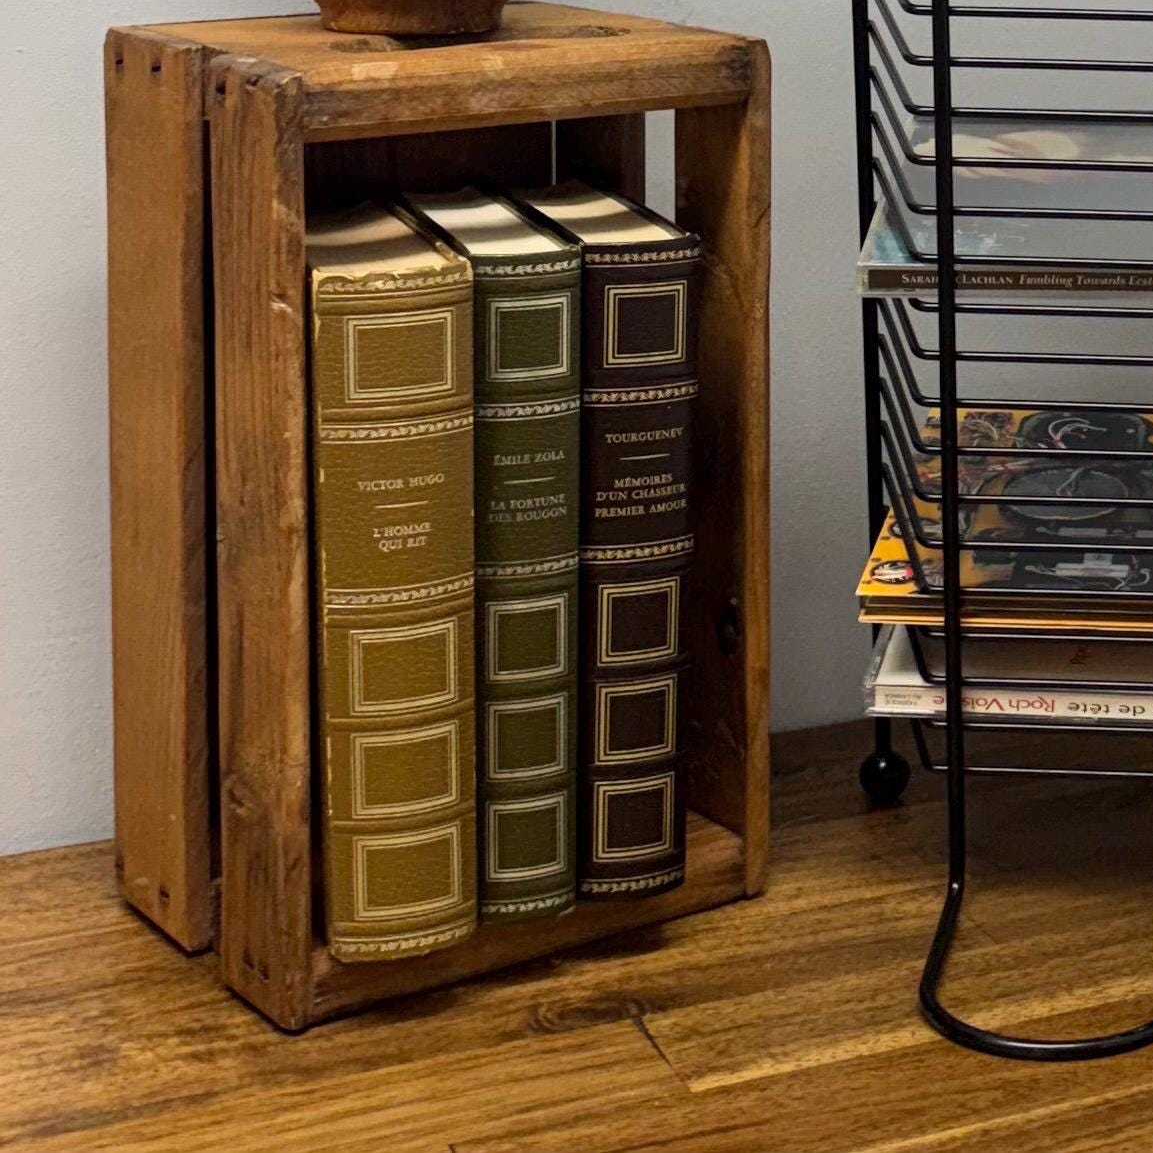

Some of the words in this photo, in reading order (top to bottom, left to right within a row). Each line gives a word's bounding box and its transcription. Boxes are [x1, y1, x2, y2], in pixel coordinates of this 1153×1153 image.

[1018, 274, 1074, 288] Fumbling
[1076, 275, 1127, 286] Towards
[604, 427, 685, 443] TOURGUENEV
[493, 452, 531, 466] ÉMILE
[533, 450, 566, 463] ZOLA
[357, 479, 405, 491] VICTOR
[409, 473, 446, 487] HUGO
[613, 473, 673, 488] MÉMOIRES
[596, 490, 629, 501] D'UN
[631, 482, 687, 500] CHASSEUR
[490, 500, 506, 511] LA
[510, 494, 567, 509] FORTUNE
[594, 505, 646, 518] PREMIER
[649, 499, 688, 513] AMOUR
[516, 506, 569, 522] ROUGON
[372, 521, 433, 538] L'HOMME
[378, 538, 403, 552] QUI
[406, 536, 428, 547] RIT
[1008, 696, 1056, 714] Roch
[1067, 701, 1110, 715] tête
[1118, 703, 1145, 716] de
